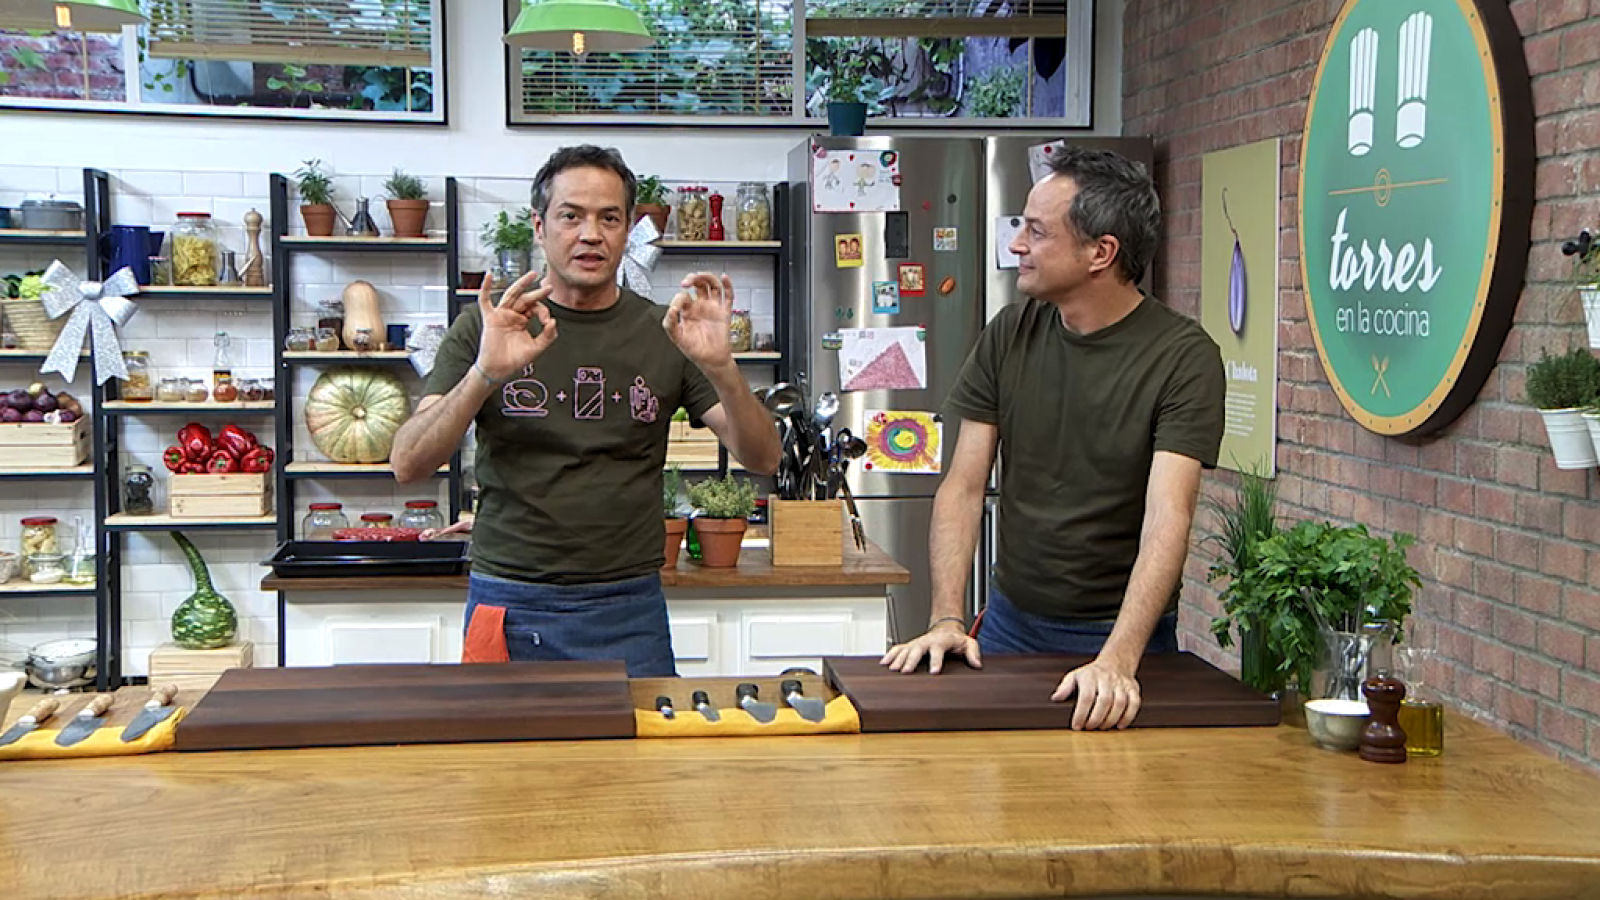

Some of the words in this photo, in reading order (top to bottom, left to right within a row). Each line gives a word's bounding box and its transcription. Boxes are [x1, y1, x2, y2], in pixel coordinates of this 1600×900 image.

[1329, 207, 1443, 292] torres
[1336, 307, 1354, 332] en
[1358, 300, 1370, 334] la
[1374, 302, 1430, 337] cocina
